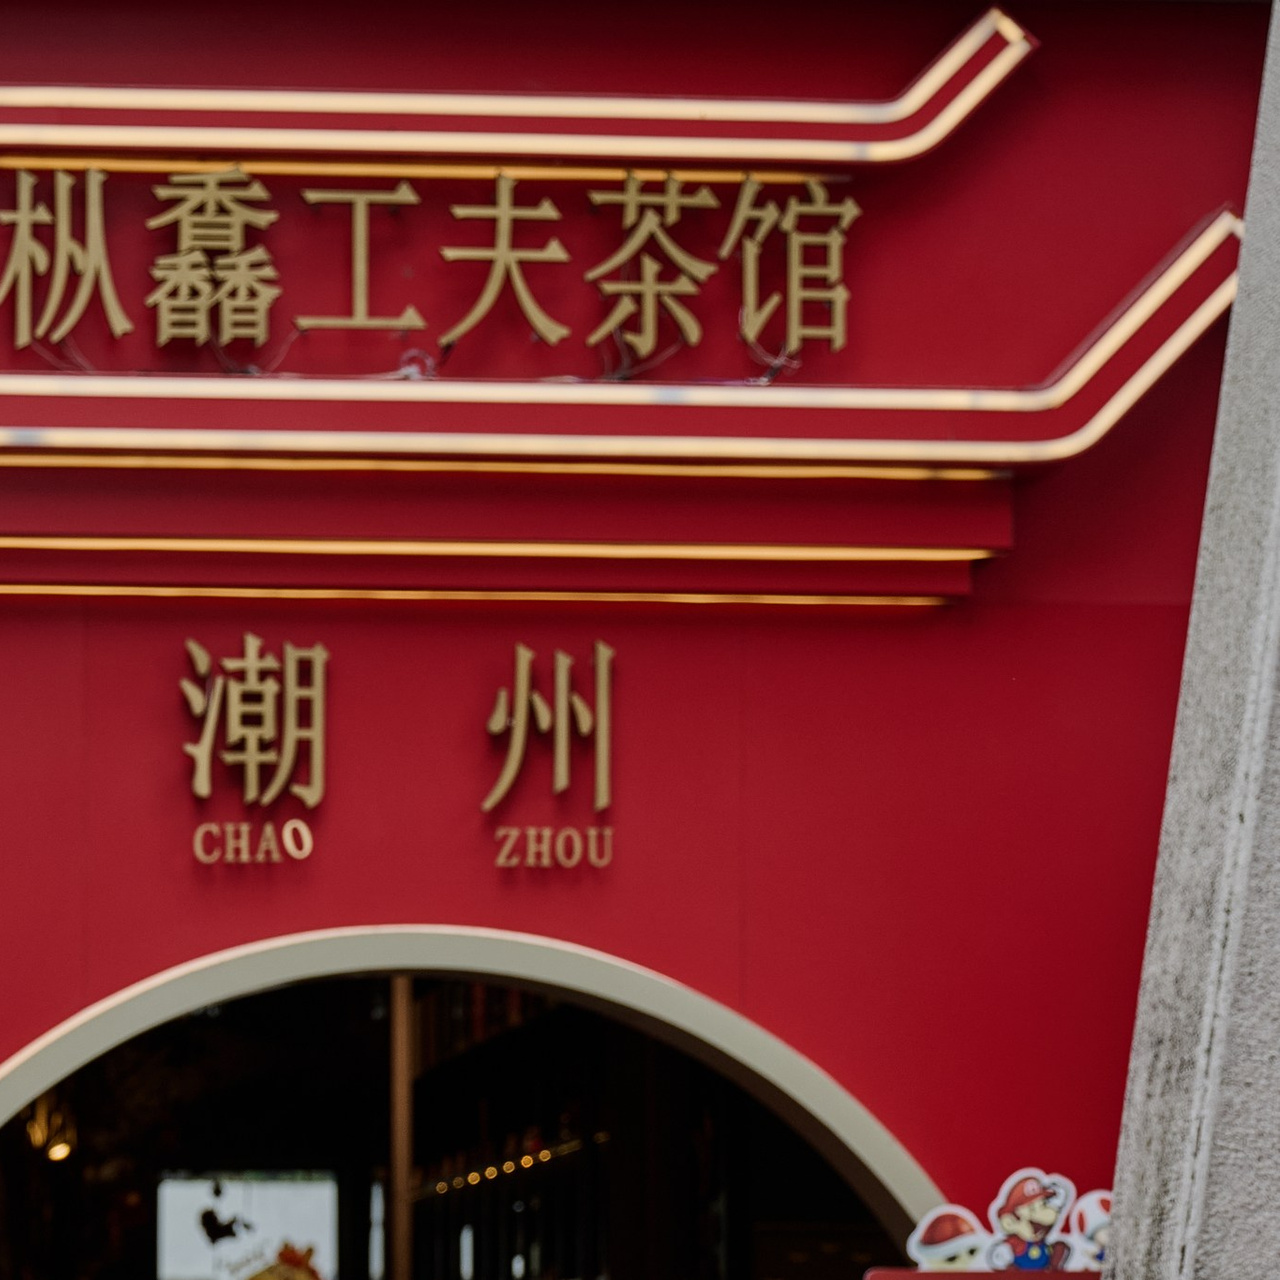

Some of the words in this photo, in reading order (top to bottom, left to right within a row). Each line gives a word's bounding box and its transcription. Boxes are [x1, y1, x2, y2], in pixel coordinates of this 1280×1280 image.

[180, 633, 615, 812] 潮州
[193, 818, 314, 864] CHAO
[494, 826, 615, 868] ZHOU
